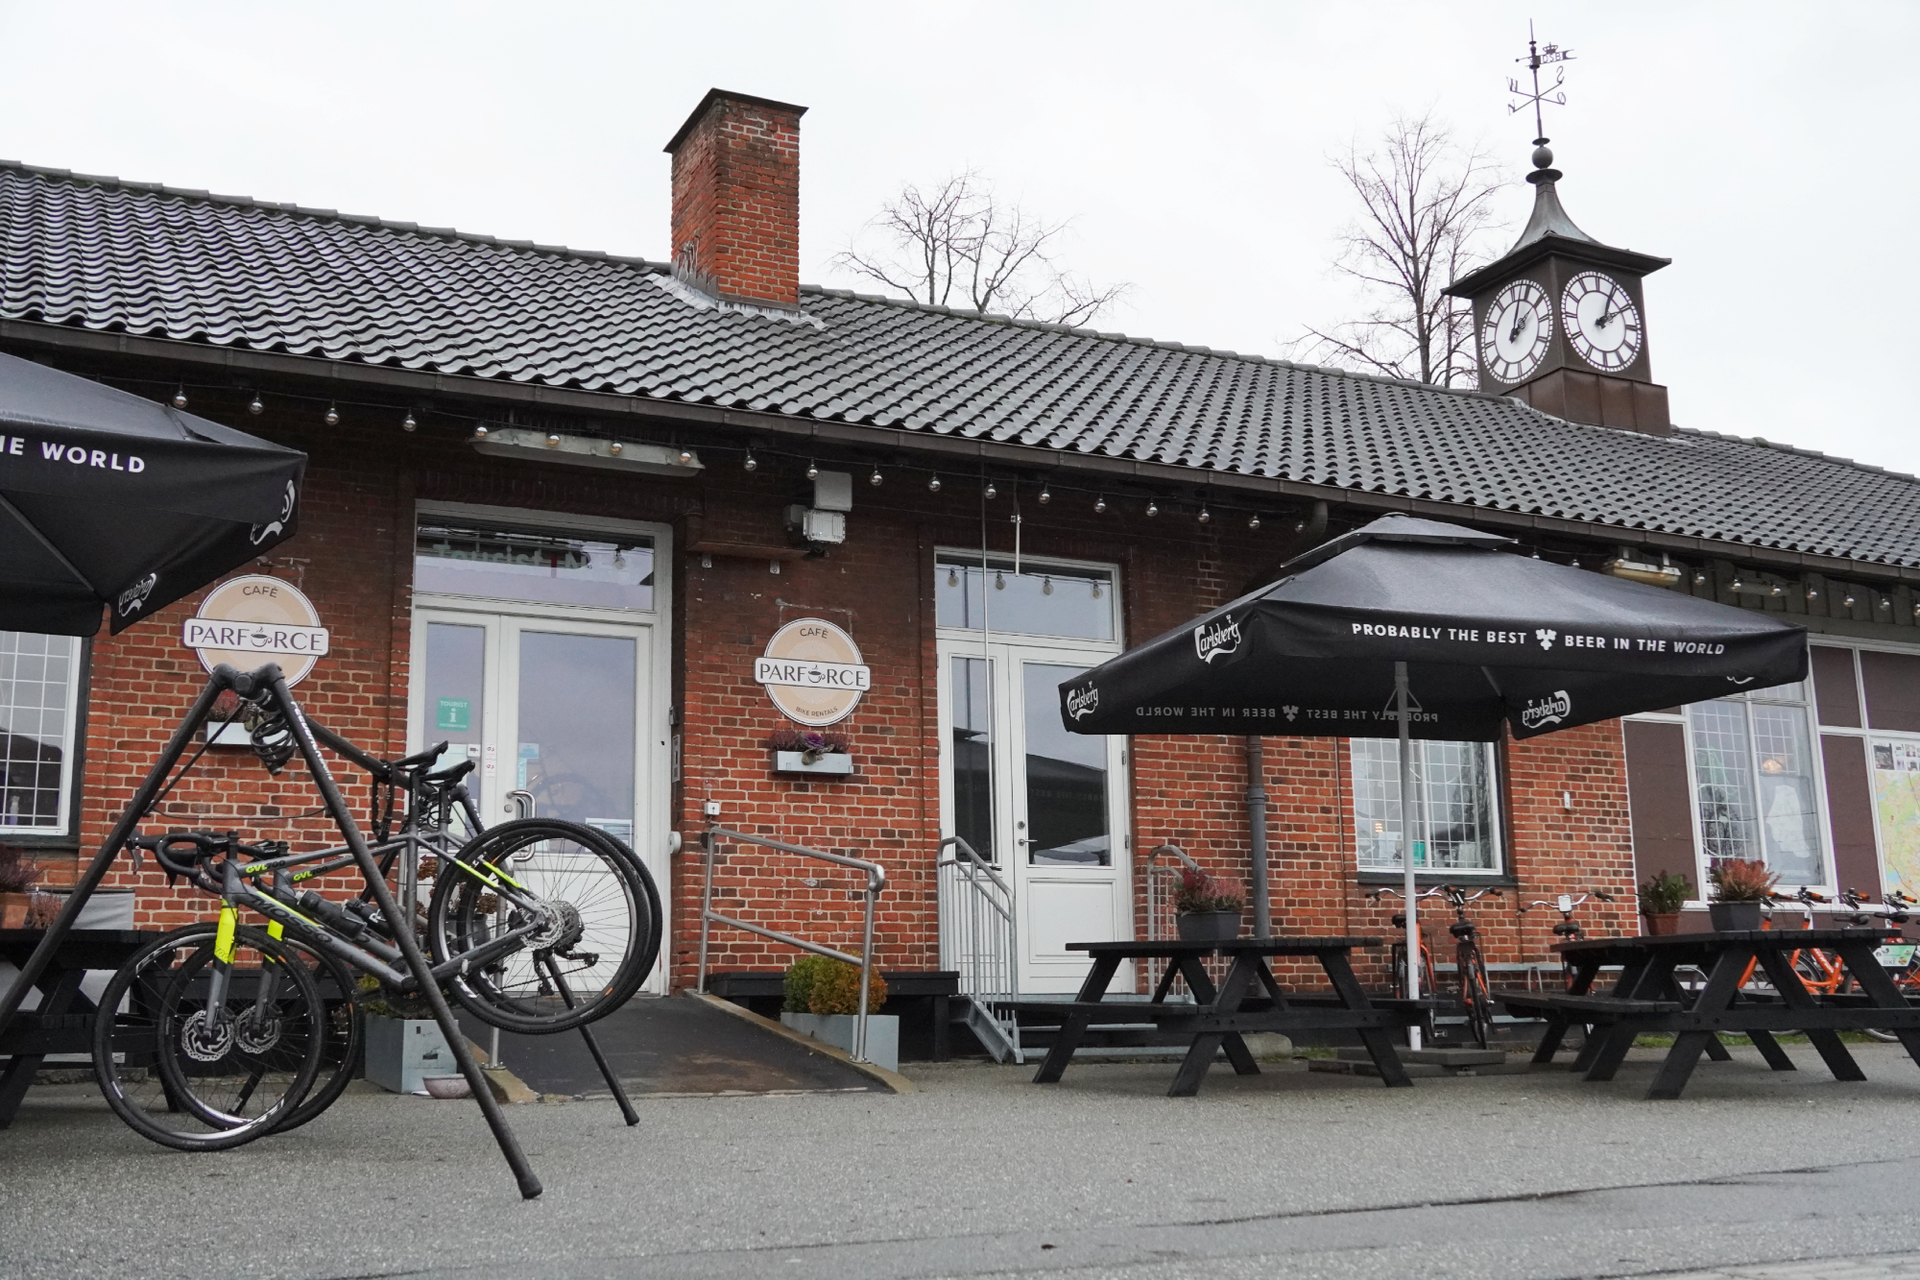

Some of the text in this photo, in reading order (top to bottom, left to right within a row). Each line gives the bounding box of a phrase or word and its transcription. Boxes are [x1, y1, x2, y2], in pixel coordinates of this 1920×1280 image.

[1542, 52, 1561, 63] DSB
[41, 441, 145, 473] WORLD
[1194, 617, 1241, 661] Carlsberg
[1352, 623, 1725, 656] PROBABLY THE BEST BEER IN THE WORLD
[439, 700, 468, 708] TOURIST
[795, 706, 838, 717] BIKE RENTALS
[1066, 684, 1099, 719] Carlsberg
[251, 896, 333, 942] MOSSO
